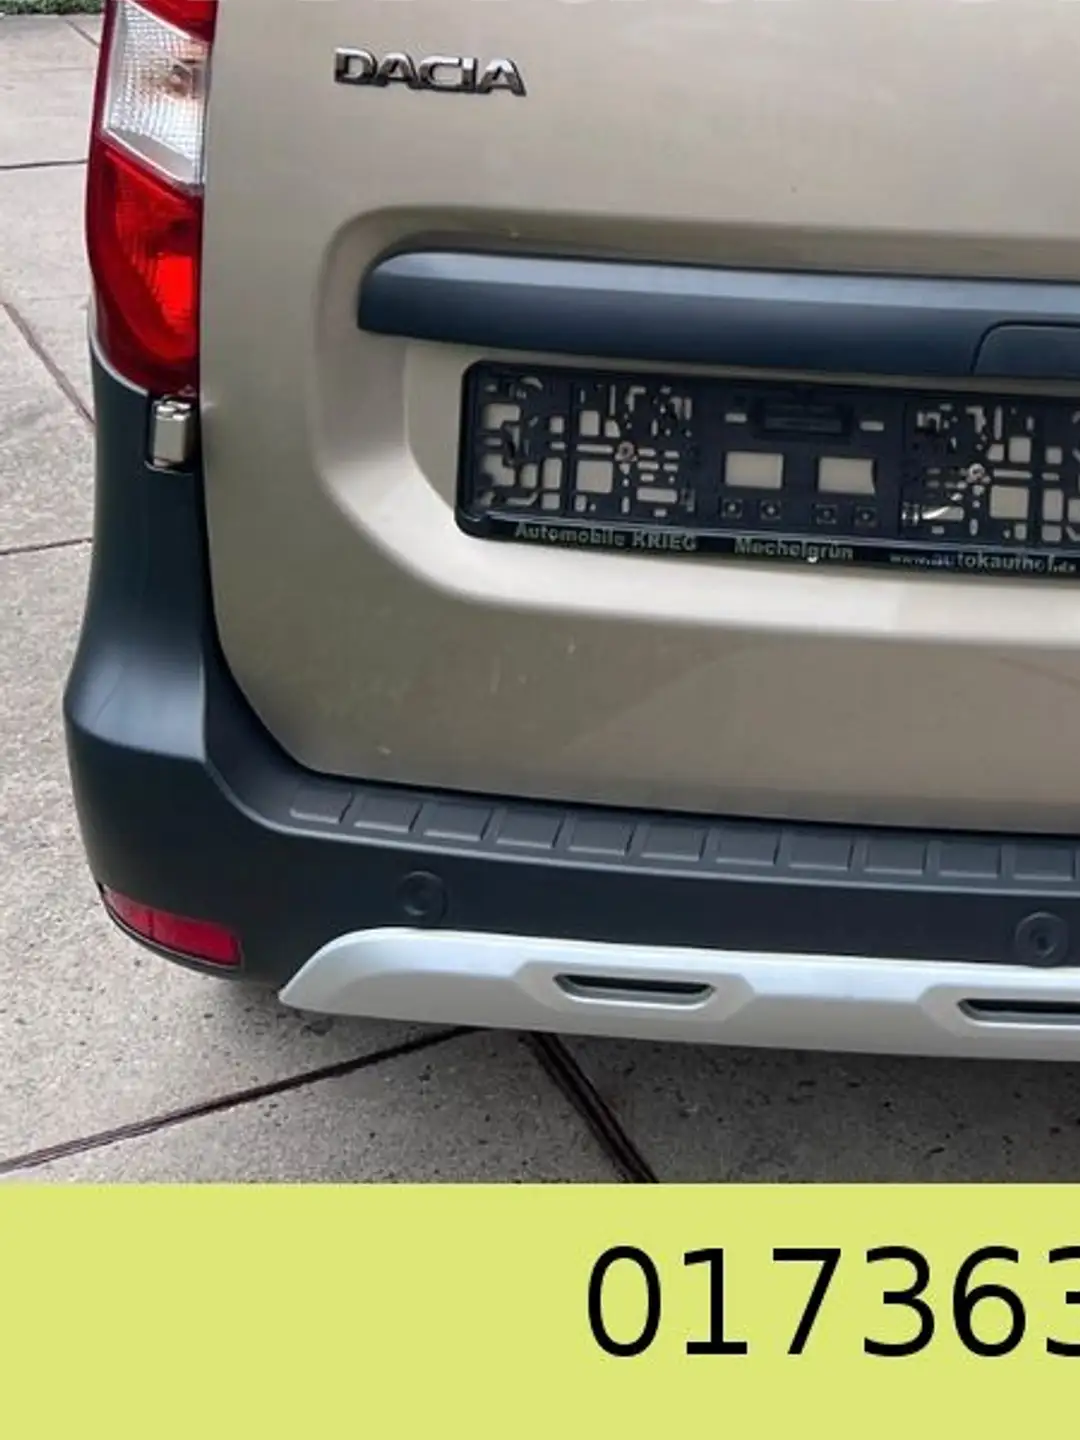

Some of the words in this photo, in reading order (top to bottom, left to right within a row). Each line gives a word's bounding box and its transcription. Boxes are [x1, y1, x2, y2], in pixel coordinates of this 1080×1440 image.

[333, 47, 527, 97] DACIA
[514, 522, 625, 547] Automobile
[631, 531, 697, 552] KRIEG
[733, 536, 854, 561] Mechelgrün
